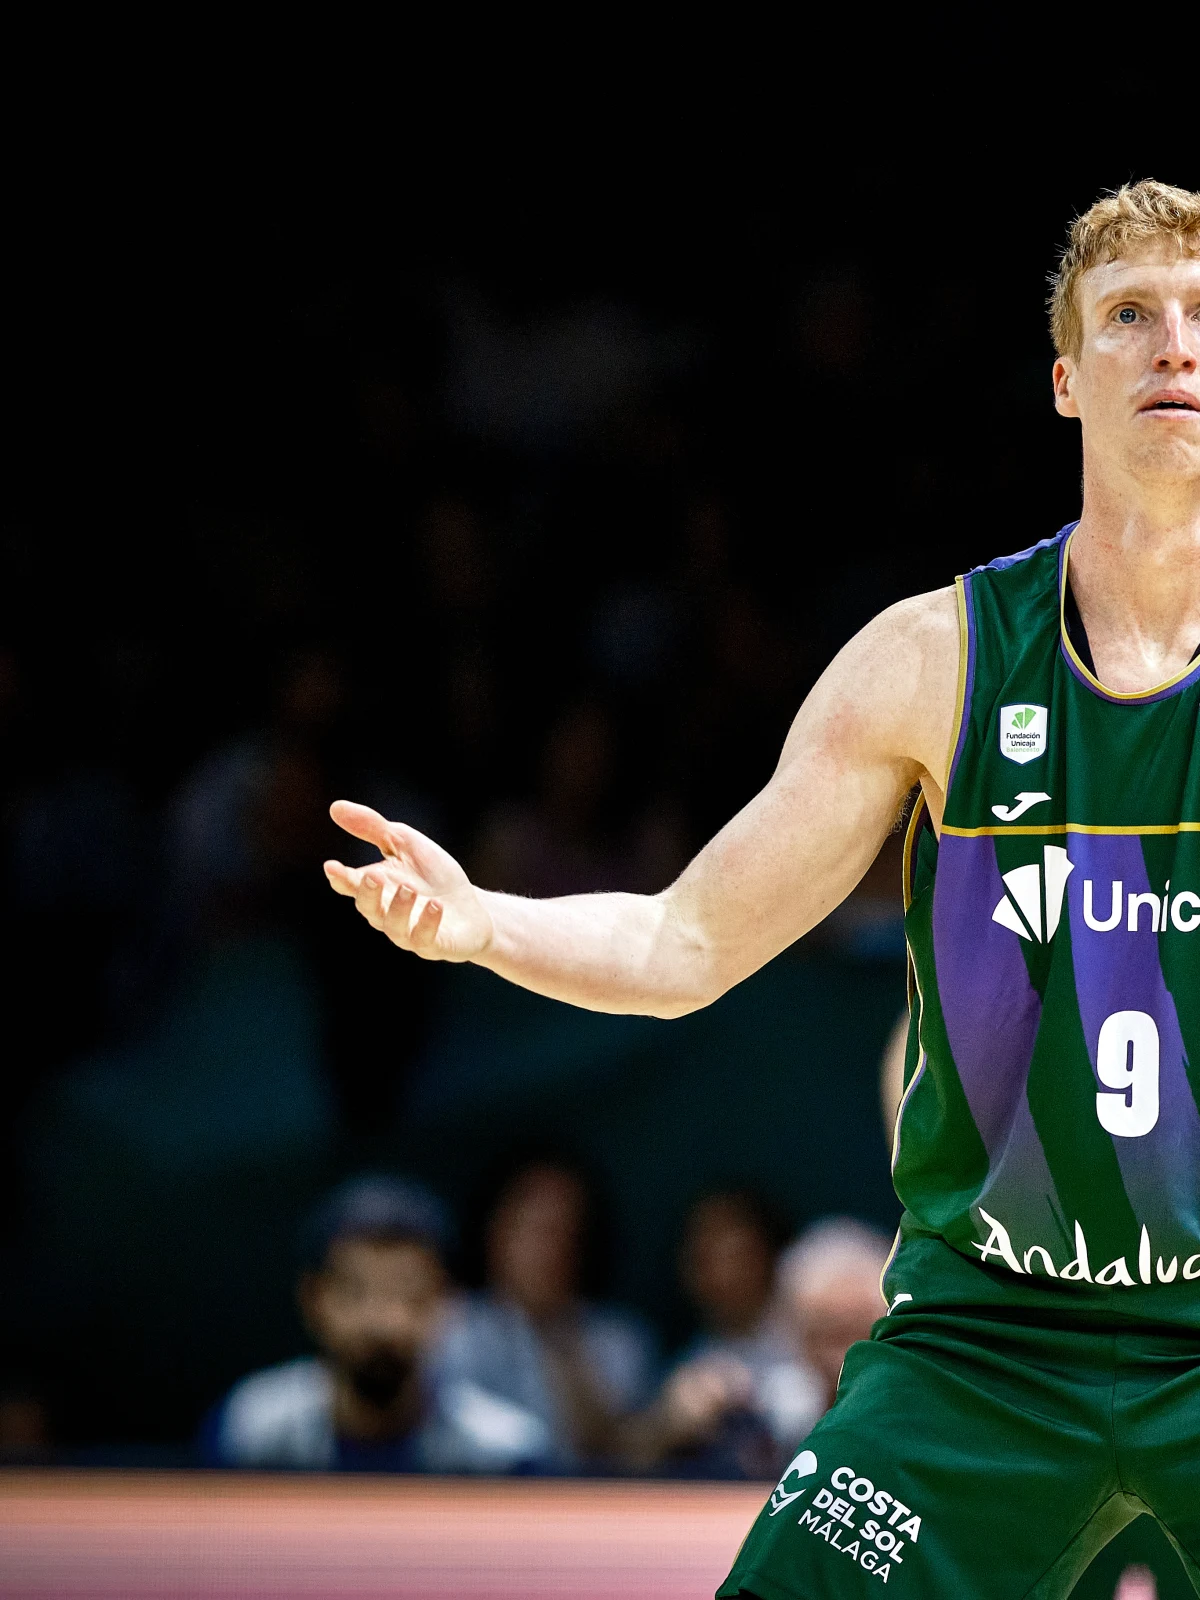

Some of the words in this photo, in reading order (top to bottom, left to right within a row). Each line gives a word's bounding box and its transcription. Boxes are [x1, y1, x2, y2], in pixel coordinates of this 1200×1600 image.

[1006, 732, 1040, 740] Fundación
[1011, 740, 1035, 748] Unicaja
[1096, 1010, 1160, 1138] 9
[812, 1488, 857, 1529] DEL
[859, 1519, 905, 1564] SOL
[830, 1466, 922, 1543] COSTA
[797, 1509, 891, 1584] MÁLAGA
